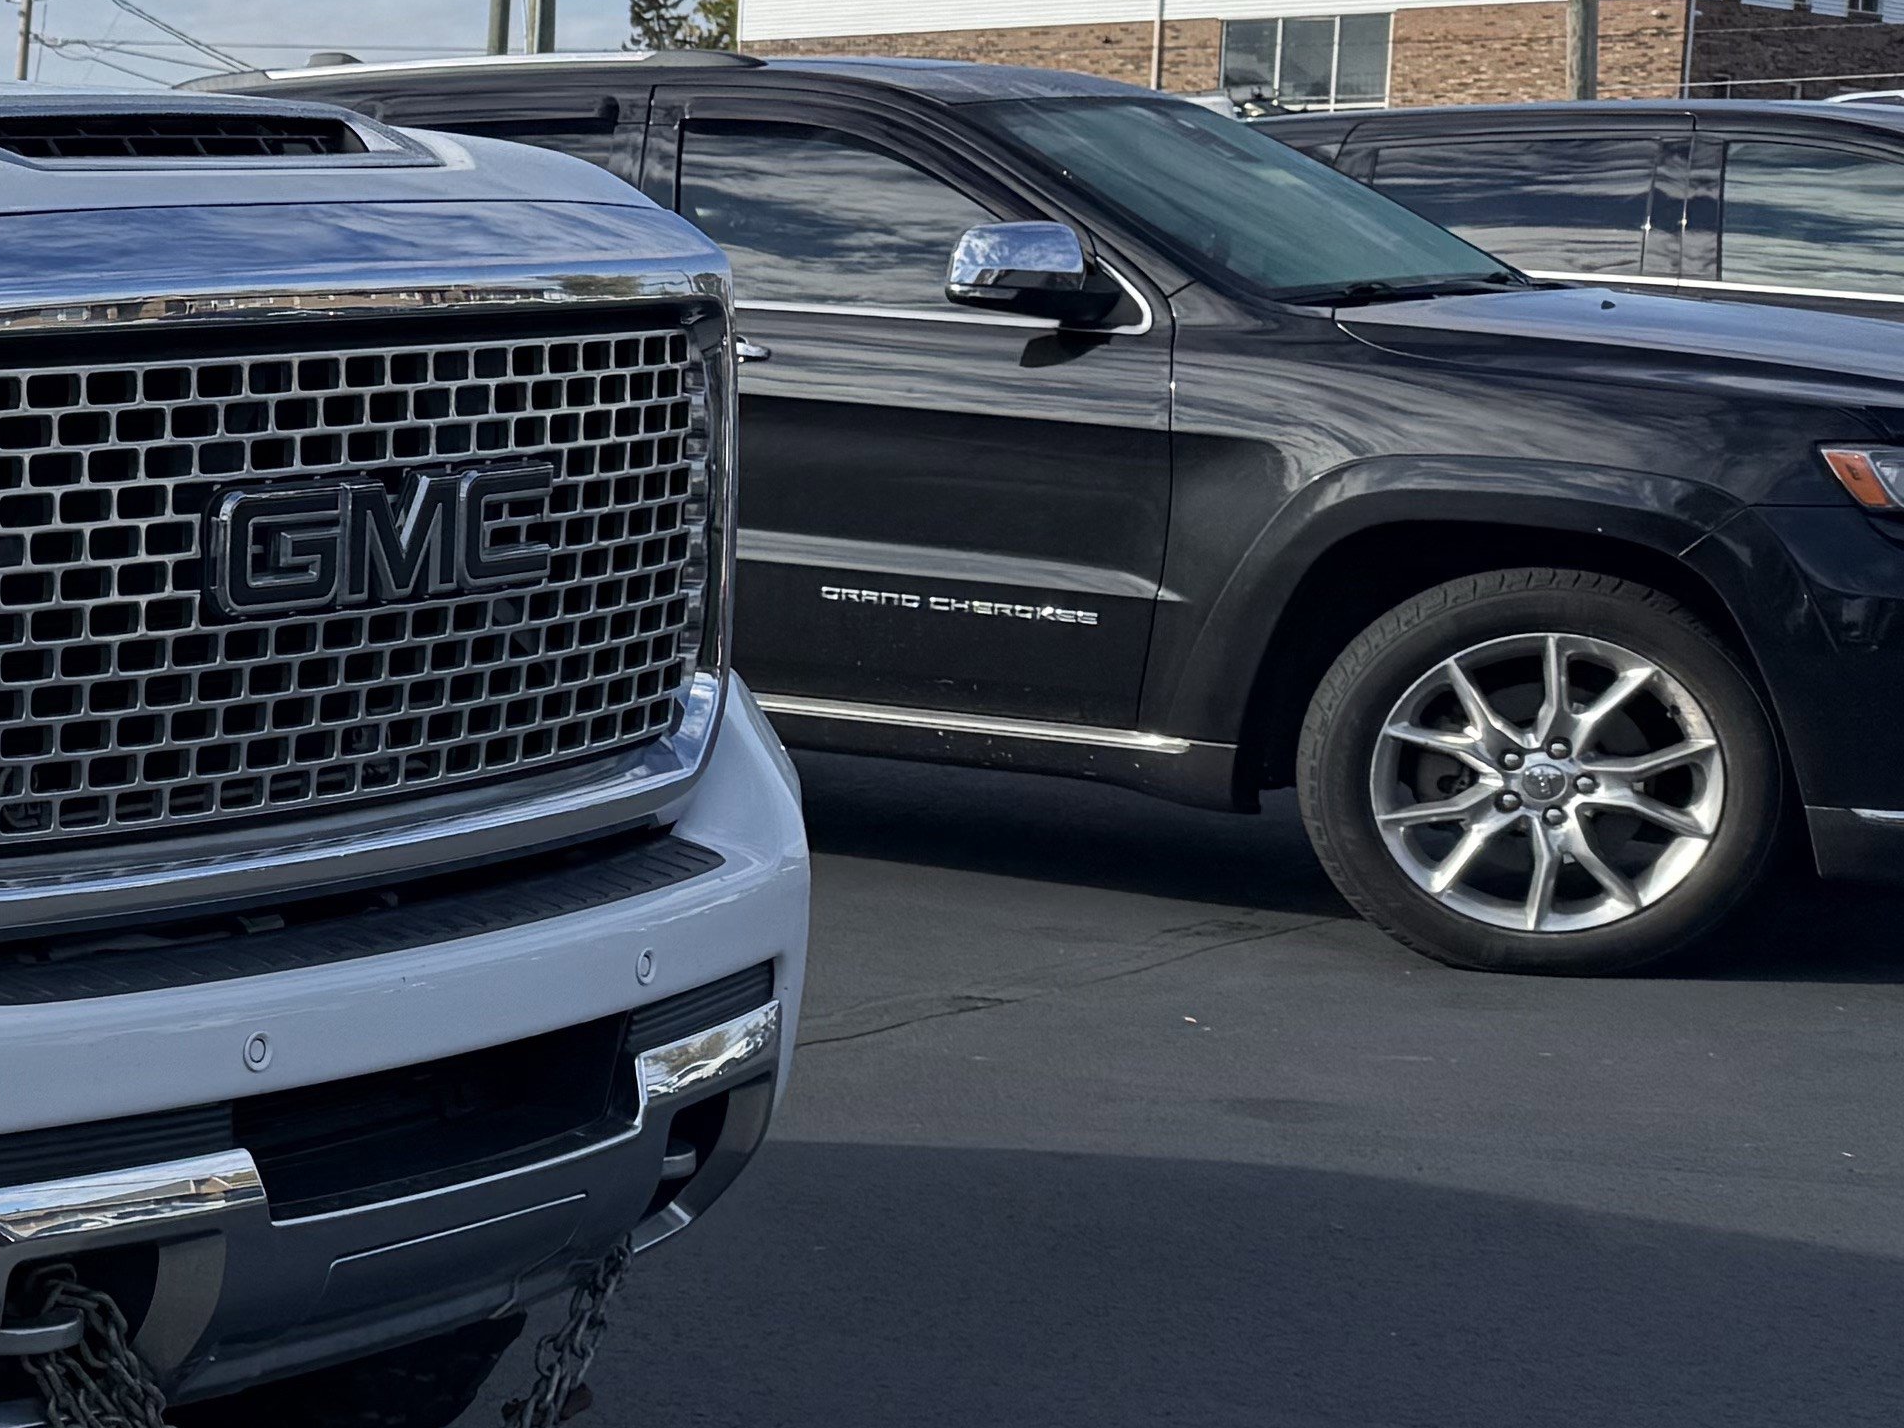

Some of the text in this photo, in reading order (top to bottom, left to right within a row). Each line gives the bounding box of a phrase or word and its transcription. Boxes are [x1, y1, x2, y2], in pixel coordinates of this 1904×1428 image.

[208, 461, 555, 616] GMC
[820, 586, 1098, 625] GRAND CHEROKEE
